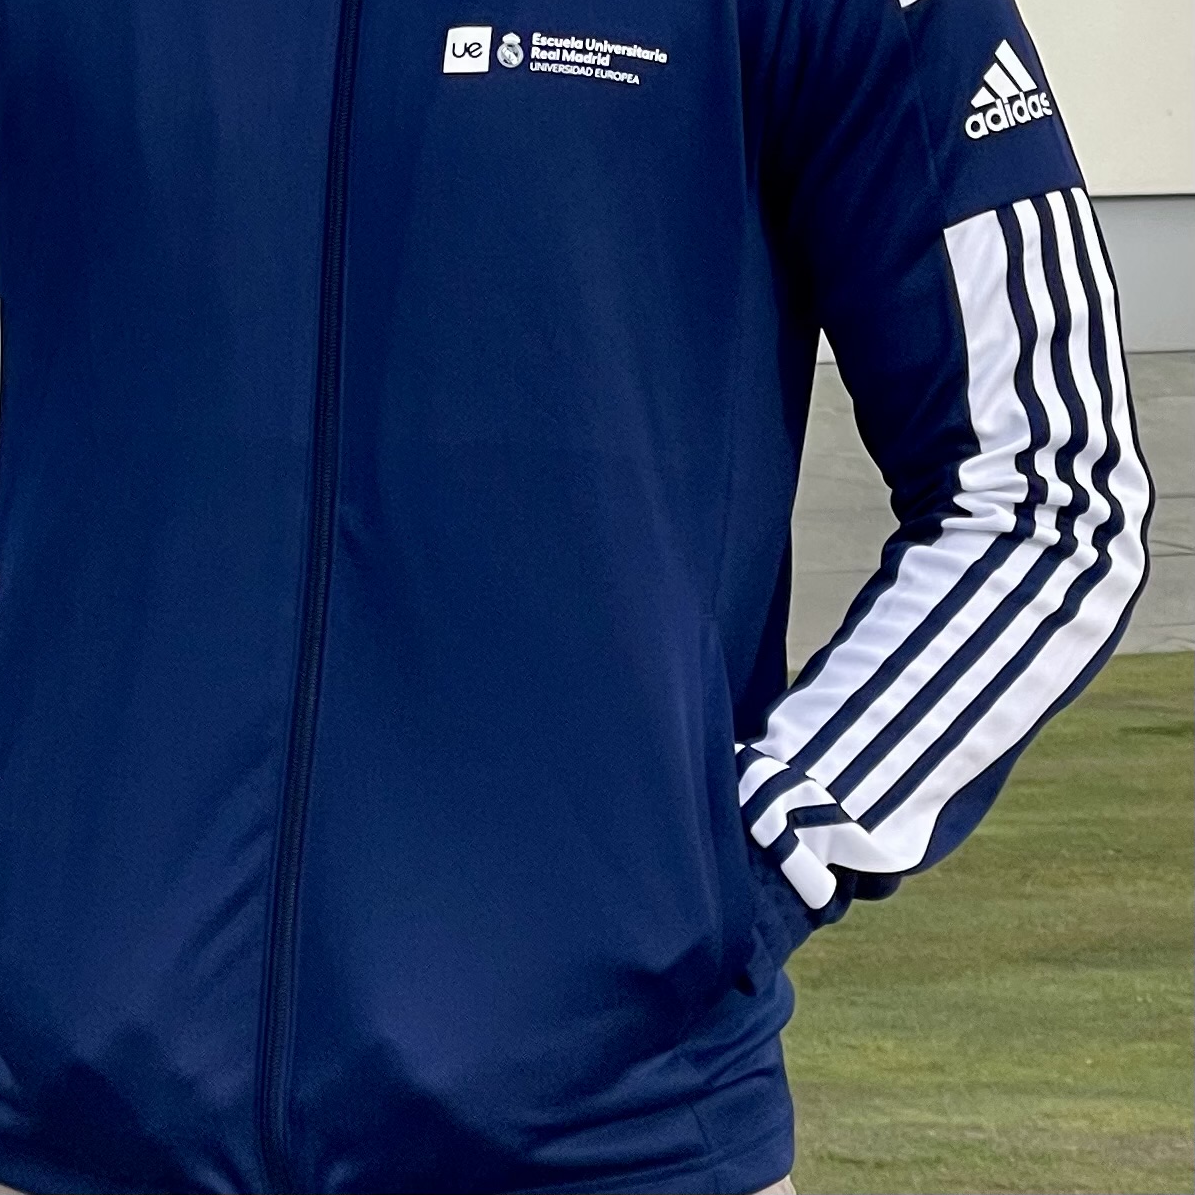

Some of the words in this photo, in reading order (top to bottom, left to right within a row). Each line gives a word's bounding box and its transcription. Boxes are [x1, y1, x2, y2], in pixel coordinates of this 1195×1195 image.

[452, 42, 483, 58] ue
[531, 46, 561, 60] Real
[562, 49, 611, 66] Madrid
[532, 32, 584, 50] Escuela
[585, 38, 668, 64] Universitaria
[530, 61, 594, 77] UNIVERSIDAD
[594, 68, 640, 85] EUROPEA
[965, 91, 1053, 140] adidas
